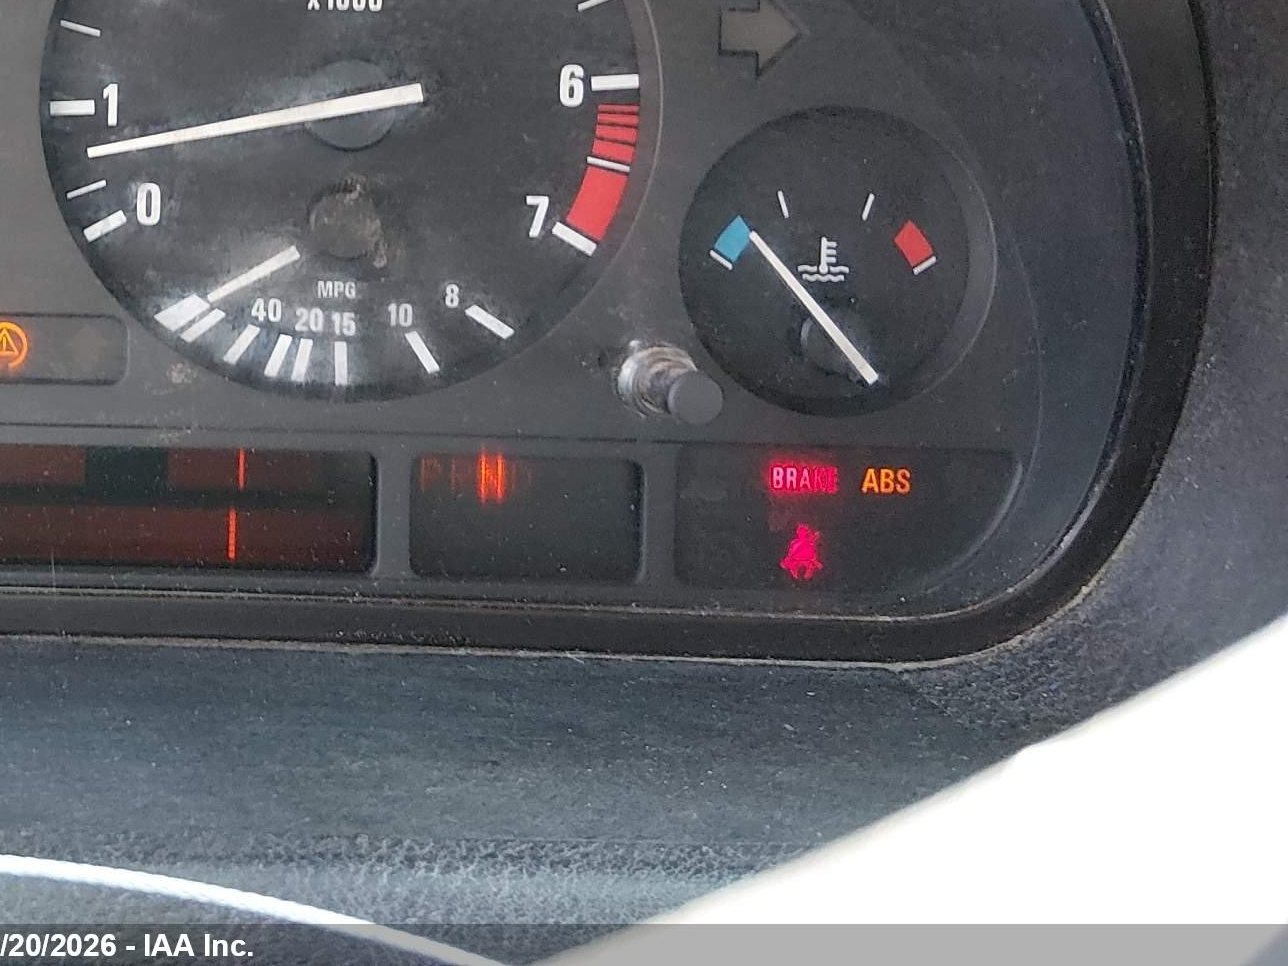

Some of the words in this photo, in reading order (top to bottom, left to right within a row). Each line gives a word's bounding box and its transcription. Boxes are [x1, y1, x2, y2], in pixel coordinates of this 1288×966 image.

[559, 64, 585, 107] 6
[102, 83, 118, 126] 1
[136, 183, 161, 227] 0
[526, 195, 550, 238] 7
[317, 280, 356, 299] MPG
[445, 284, 460, 307] 8
[251, 297, 282, 324] 40
[295, 307, 325, 332] 20
[331, 312, 357, 336] 15
[388, 302, 413, 328] 10
[771, 466, 838, 493] BRAKE
[862, 467, 911, 494] ABS
